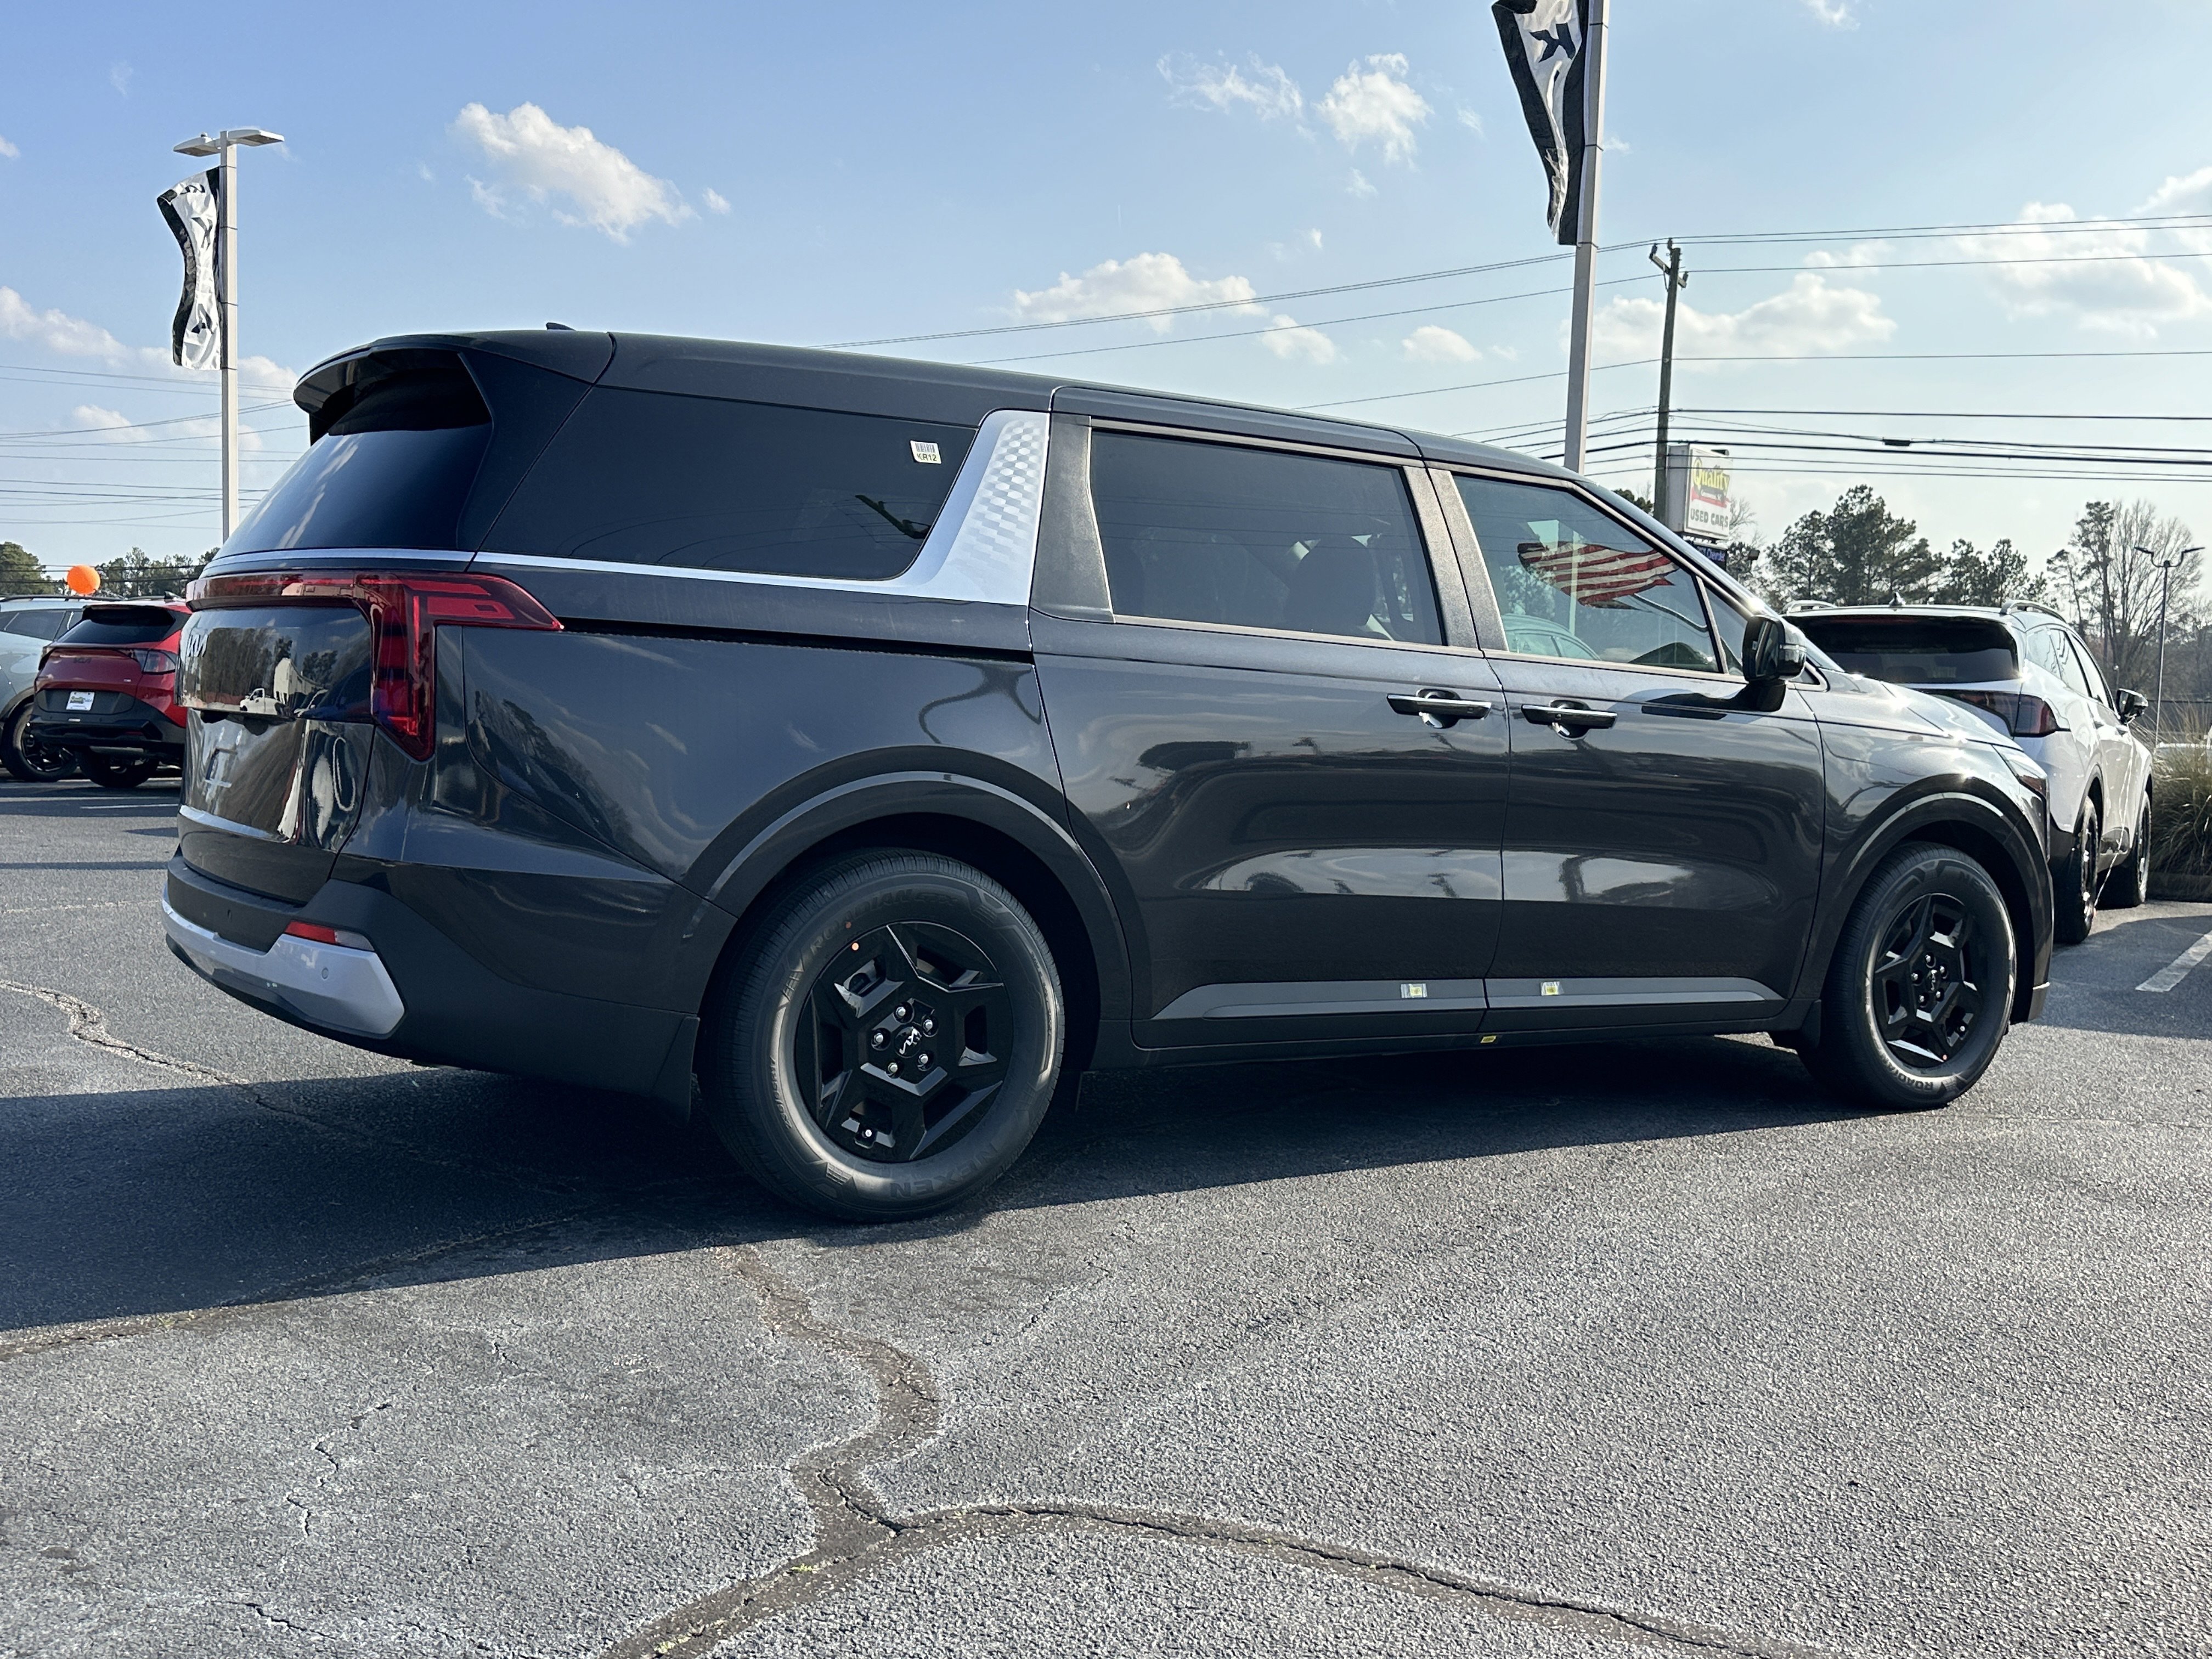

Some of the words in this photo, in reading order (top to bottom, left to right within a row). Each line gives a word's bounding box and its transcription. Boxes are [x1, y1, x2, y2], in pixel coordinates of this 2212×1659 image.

[1692, 457, 1730, 496] Quality
[1690, 508, 1709, 523] USED
[1711, 513, 1729, 528] CARS
[889, 1142, 998, 1199] NEXEN
